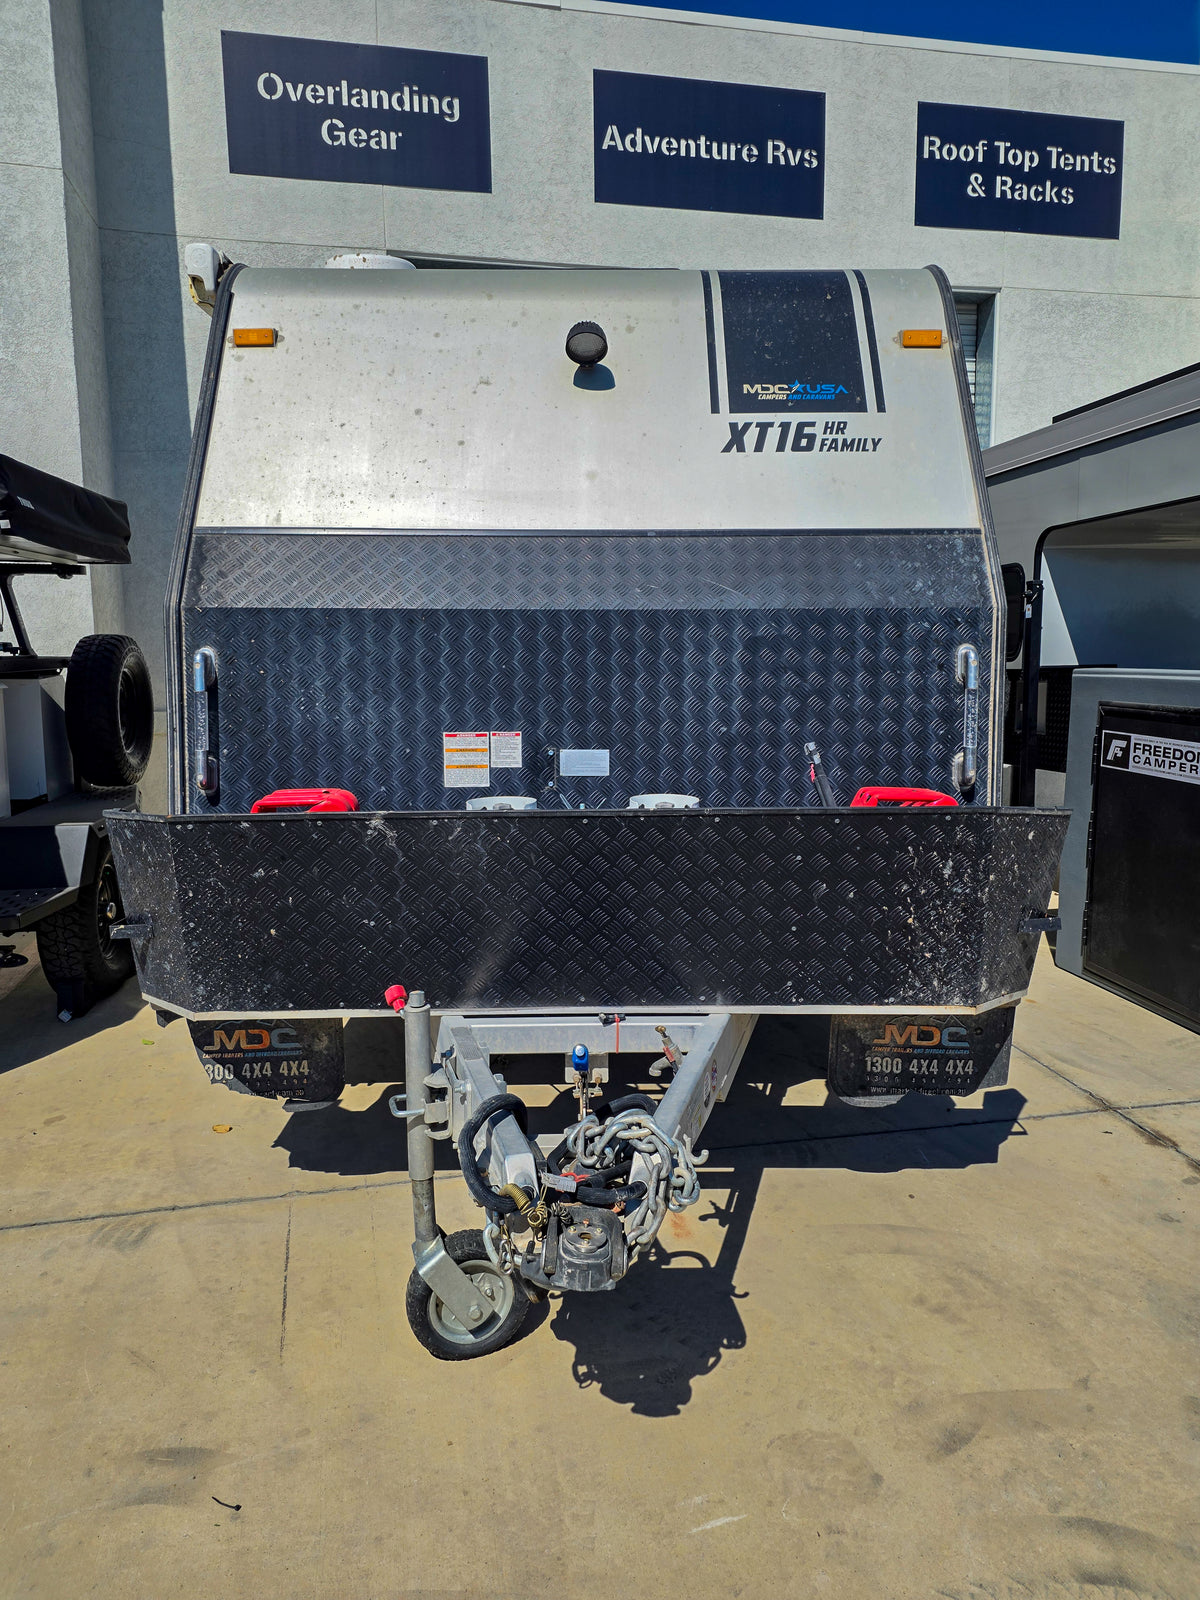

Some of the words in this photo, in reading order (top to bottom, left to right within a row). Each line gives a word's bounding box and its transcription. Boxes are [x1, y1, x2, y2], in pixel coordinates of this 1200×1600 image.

[257, 72, 461, 122] Overlanding
[321, 118, 403, 150] Gear
[602, 125, 759, 163] Adventure
[767, 139, 819, 169] Rvs
[923, 136, 988, 163] Roof
[994, 141, 1040, 173] Top
[1046, 146, 1117, 175] Tents
[966, 173, 985, 197] &
[995, 175, 1074, 205] Racks
[743, 383, 790, 394] MDC
[806, 384, 848, 394] USA
[721, 421, 817, 453] XT16
[823, 421, 848, 435] HR
[819, 438, 882, 452] FAMILY
[203, 1028, 303, 1051] MDC
[873, 1024, 970, 1047] MDC
[241, 1061, 273, 1079] 4X4
[279, 1059, 310, 1076] 4X4
[865, 1056, 902, 1074] 1300
[909, 1058, 939, 1075] 4X4
[945, 1059, 975, 1076] 4X4
